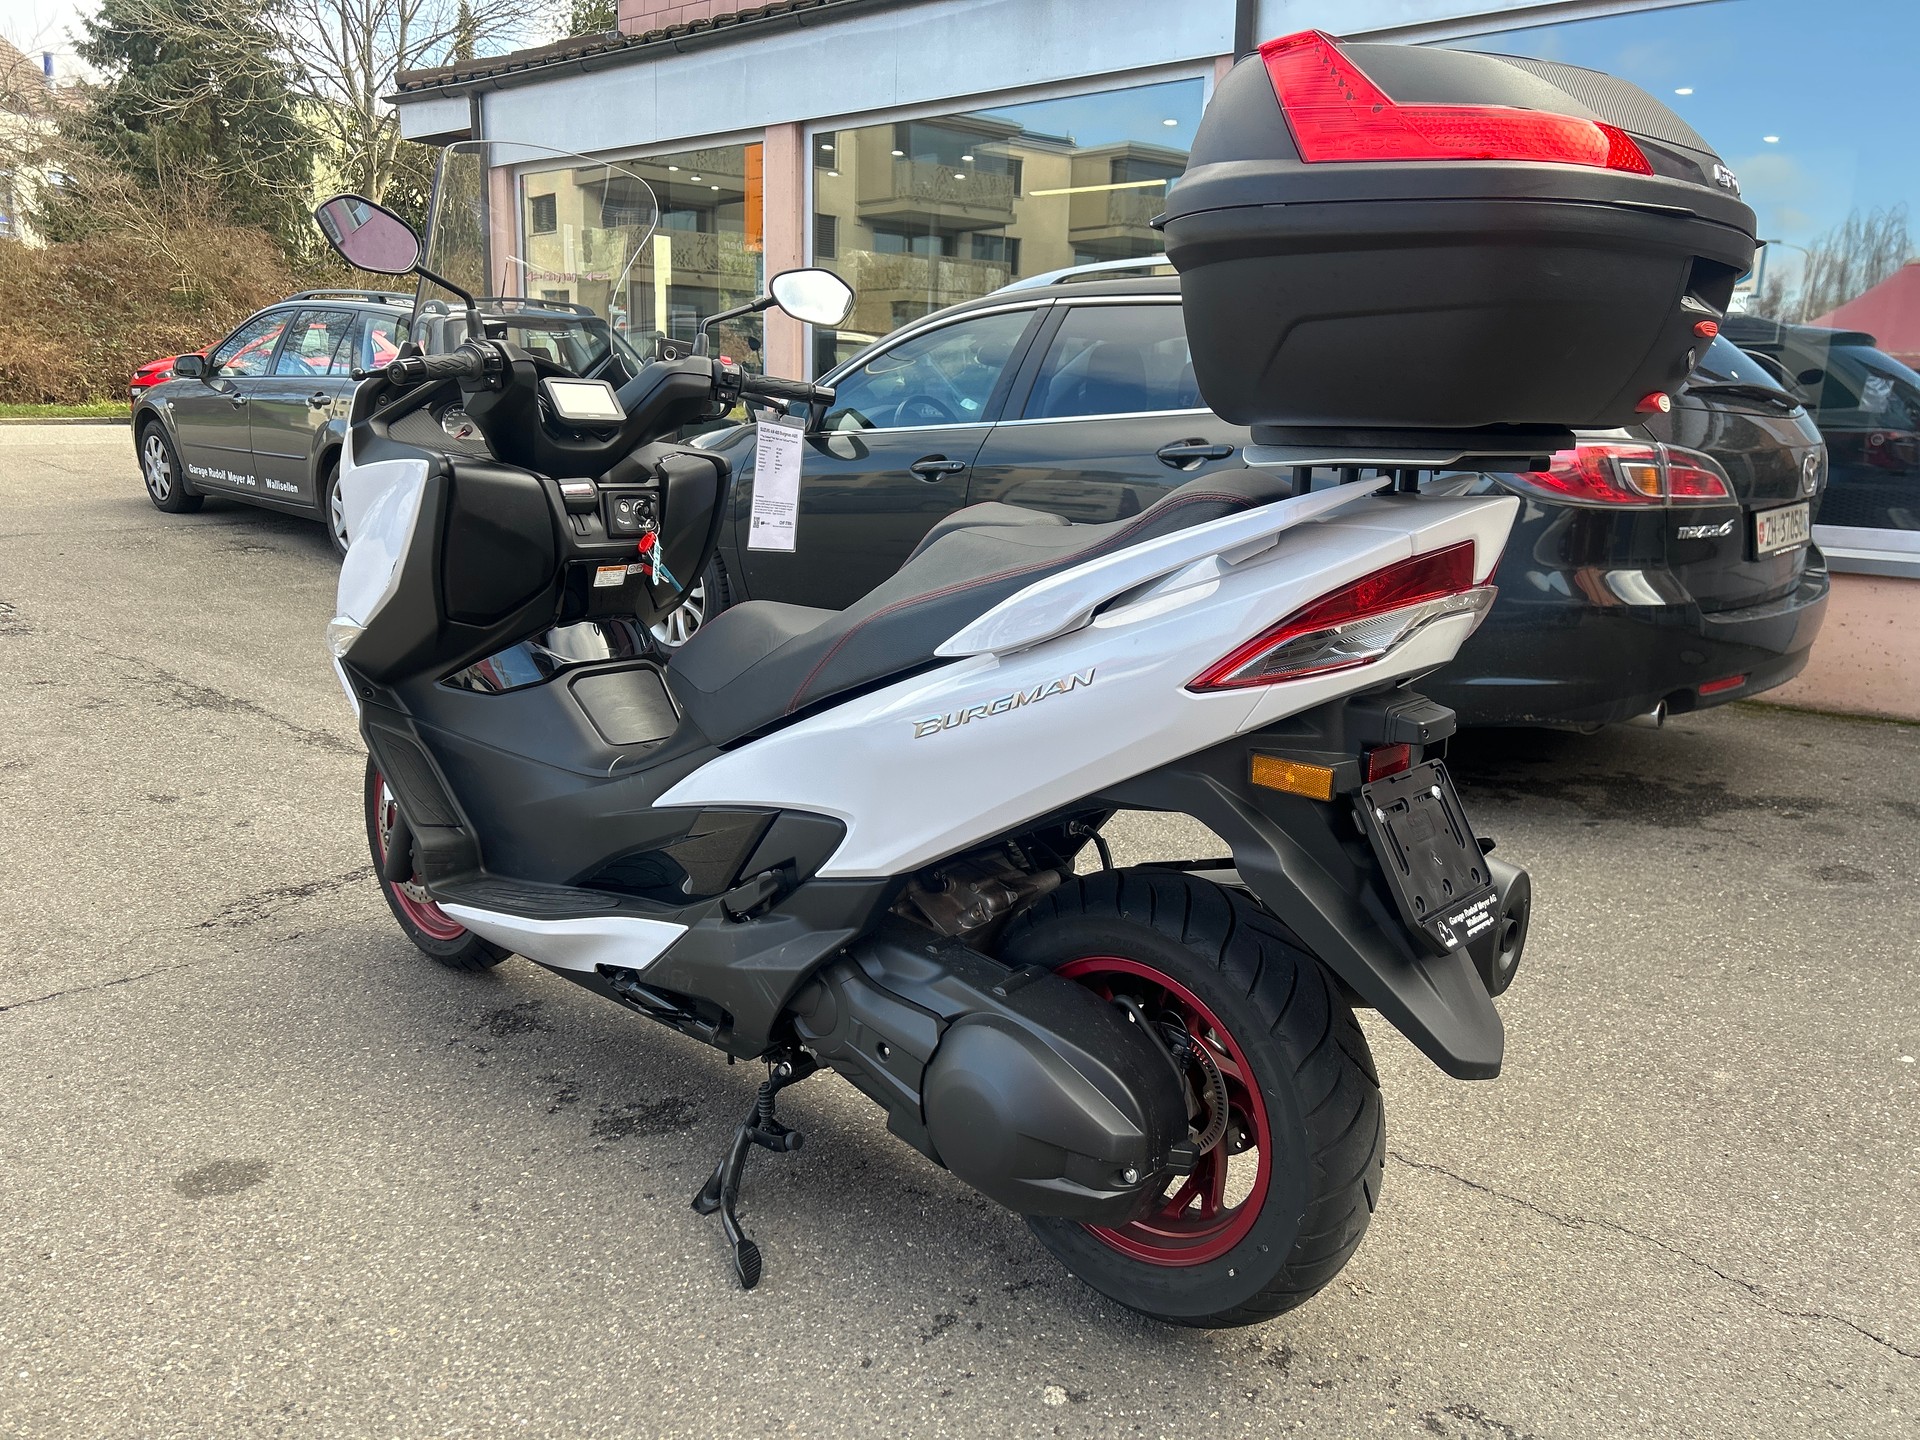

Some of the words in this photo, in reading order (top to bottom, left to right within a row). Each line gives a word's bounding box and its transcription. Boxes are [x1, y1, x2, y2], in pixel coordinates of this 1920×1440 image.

[188, 463, 208, 478] Garage
[208, 467, 226, 480] Rudolf
[227, 471, 245, 485] Meyer
[246, 475, 256, 486] AG
[265, 478, 299, 494] Wallisellen
[912, 667, 1096, 739] BURGMAN
